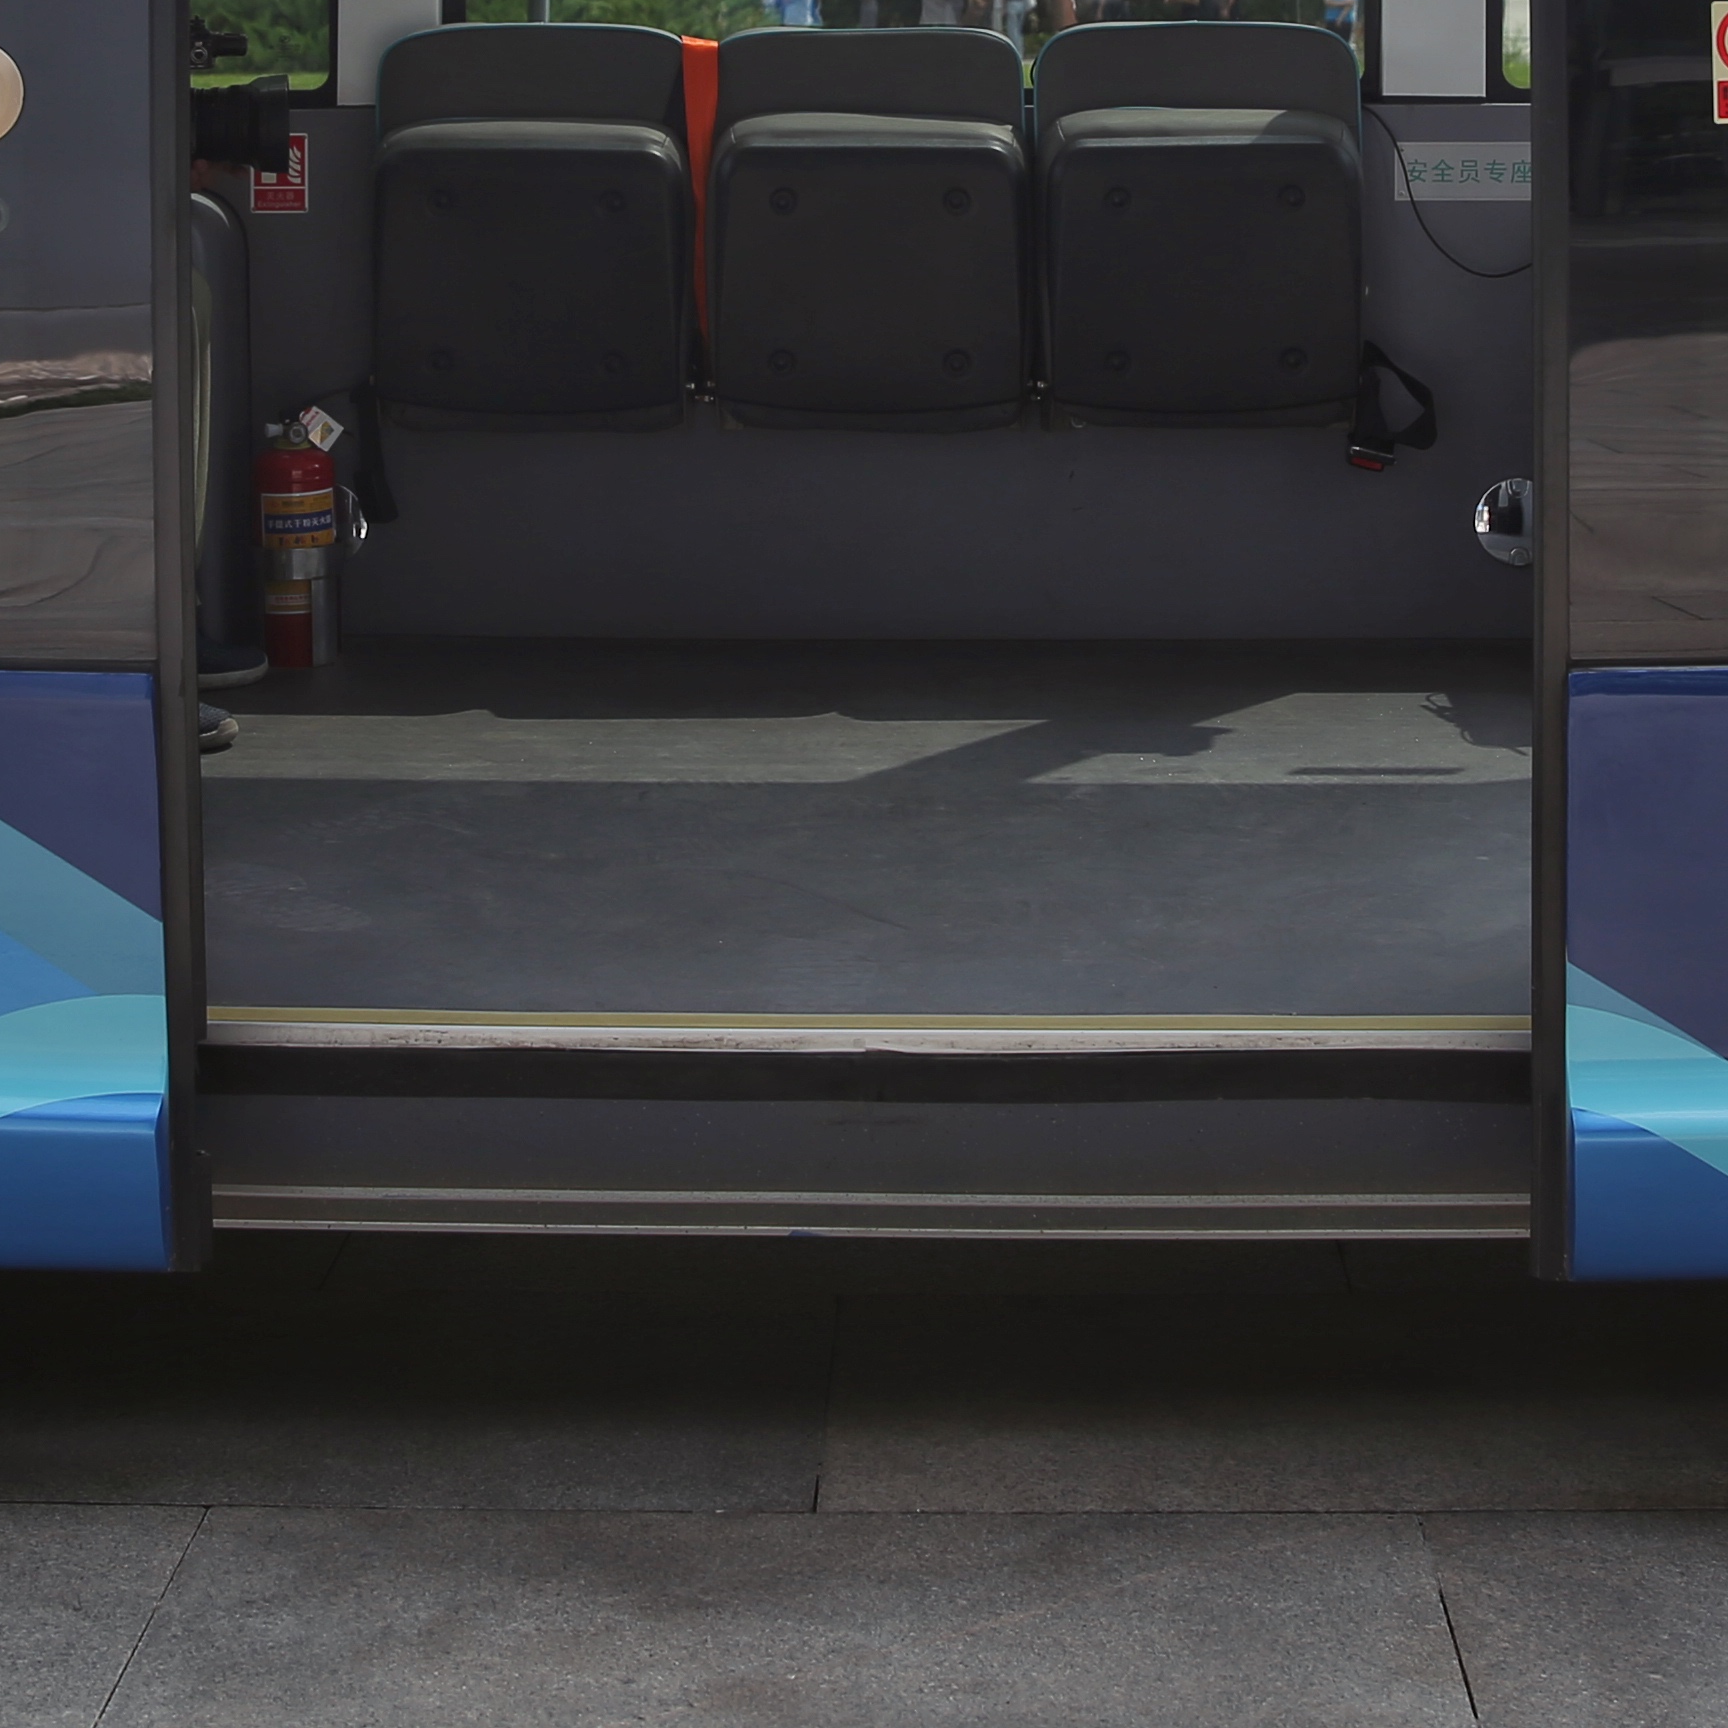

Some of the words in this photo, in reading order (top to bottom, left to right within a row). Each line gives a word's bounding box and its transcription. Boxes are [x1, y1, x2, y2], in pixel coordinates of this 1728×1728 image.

[1406, 159, 1532, 184] 安全员专座
